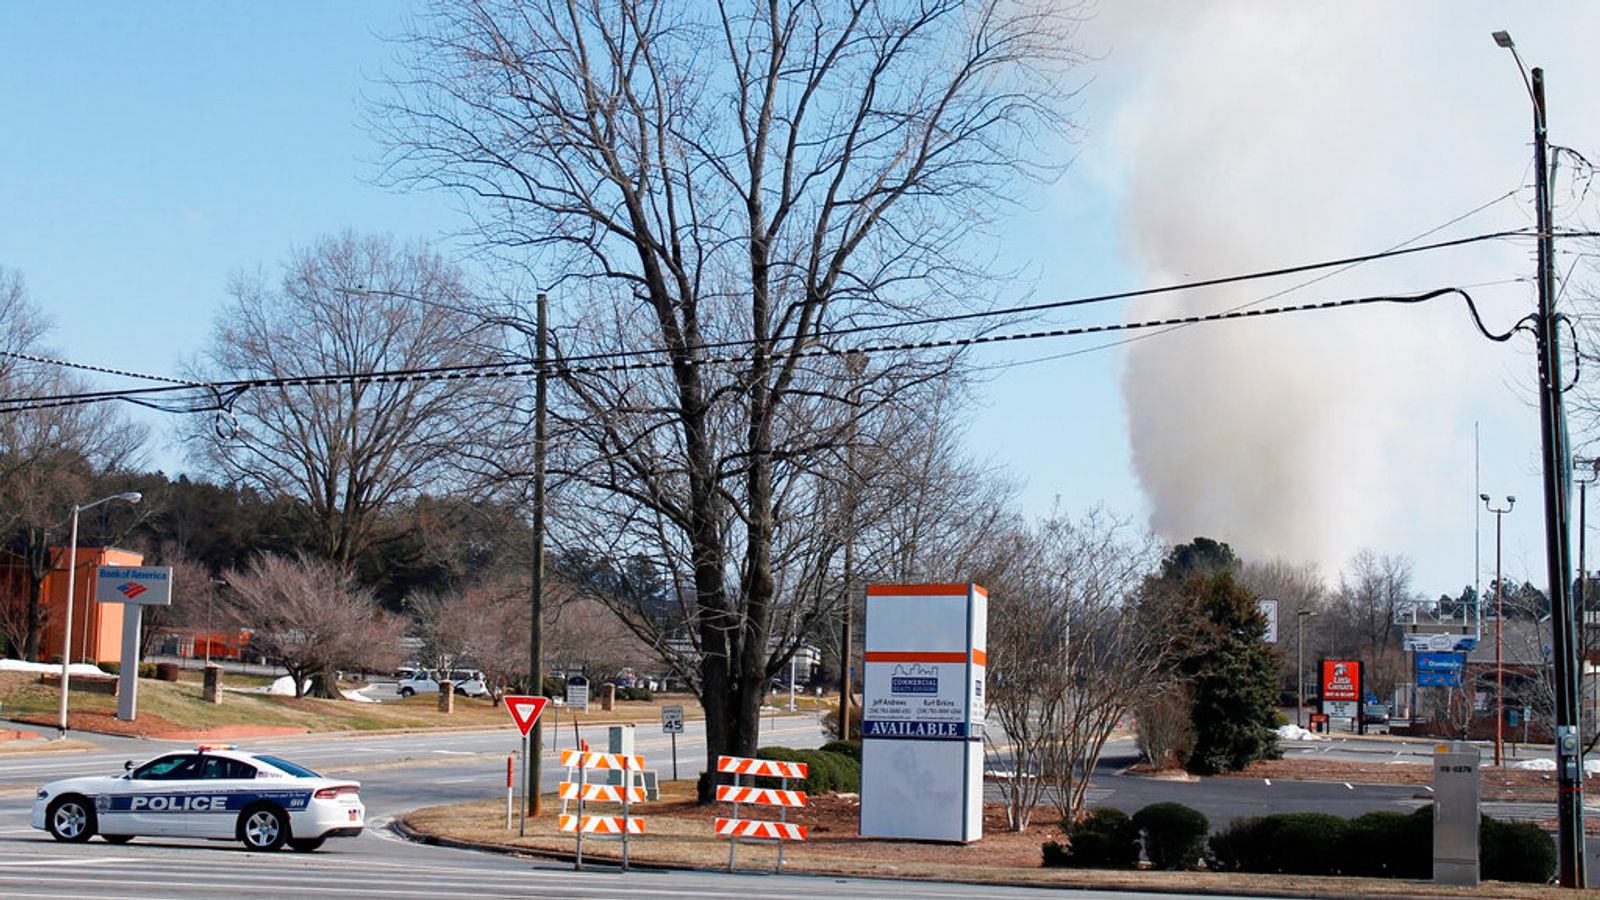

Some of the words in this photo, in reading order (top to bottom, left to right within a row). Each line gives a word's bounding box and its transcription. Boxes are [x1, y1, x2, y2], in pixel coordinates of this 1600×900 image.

[100, 569, 119, 578] Bank
[131, 570, 166, 579] America
[665, 720, 682, 730] 45
[871, 722, 957, 735] AVAILABLE
[130, 796, 228, 811] POLICE
